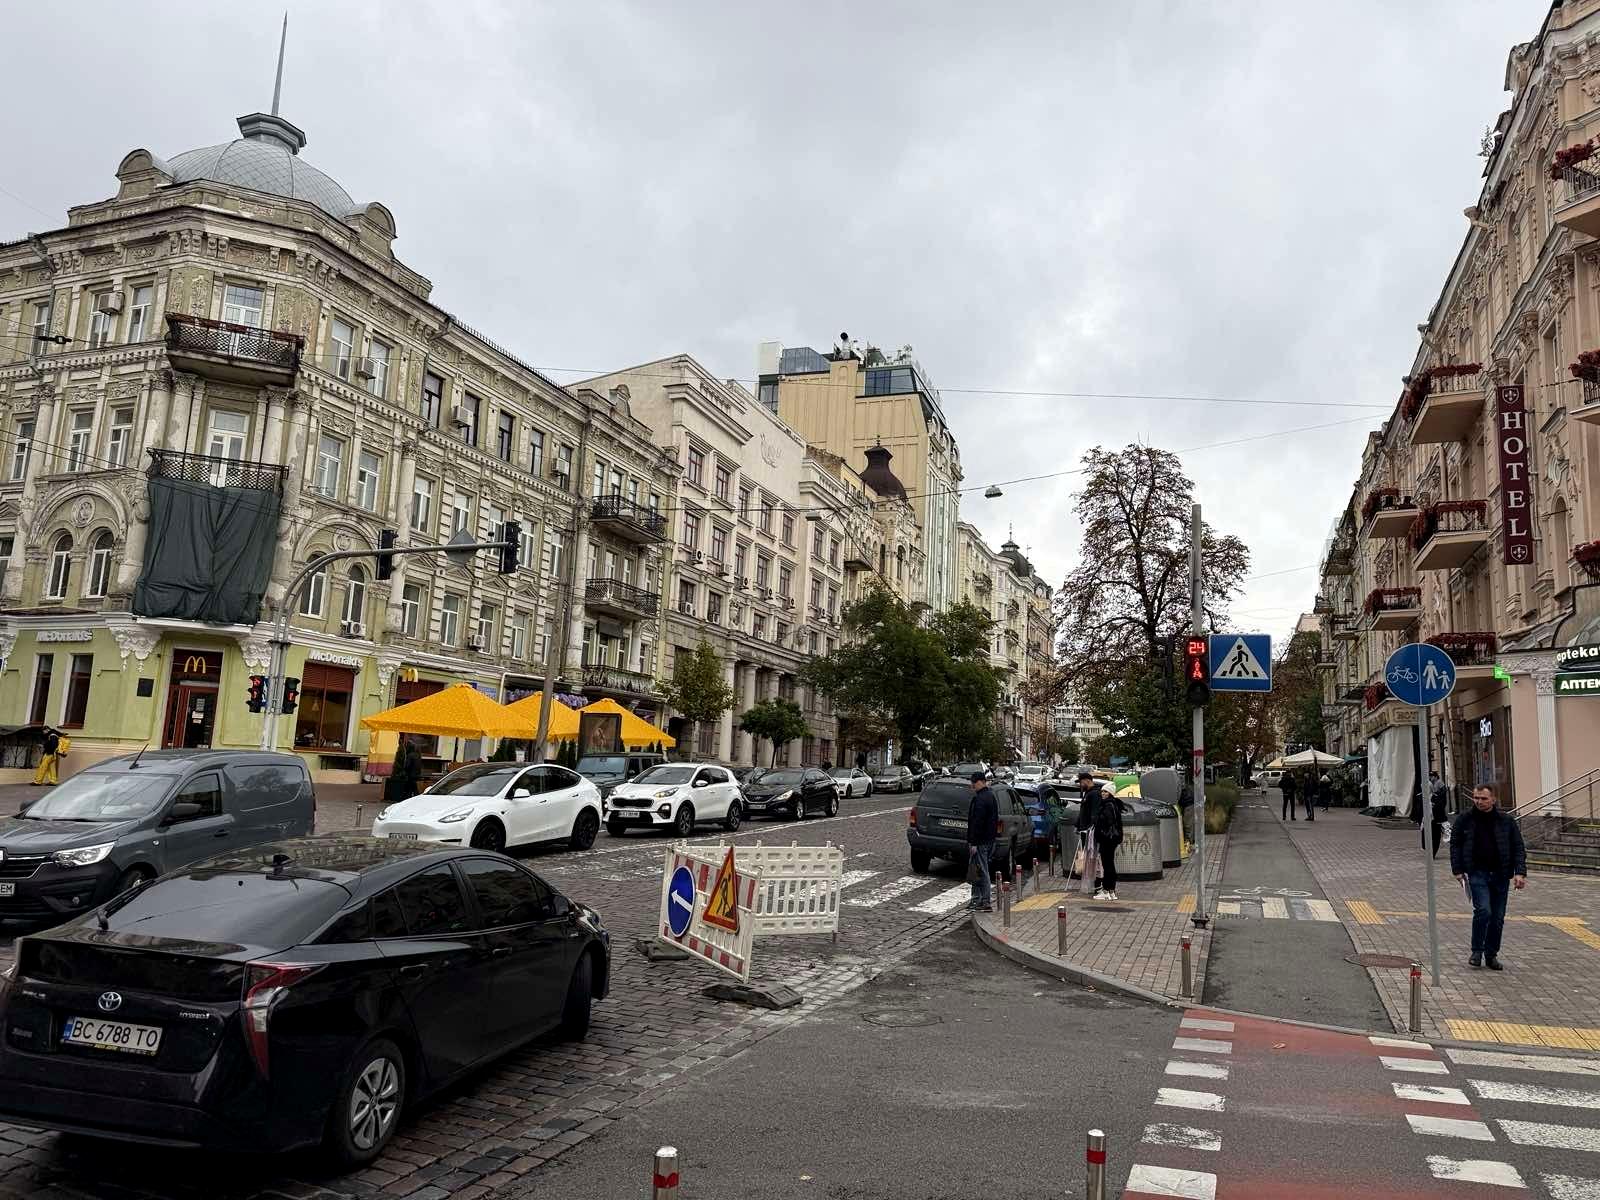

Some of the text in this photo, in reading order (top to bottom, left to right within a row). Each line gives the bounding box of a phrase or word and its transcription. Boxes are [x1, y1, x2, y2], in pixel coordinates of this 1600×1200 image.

[1501, 411, 1527, 537] HOTEL
[1189, 641, 1205, 654] 24
[73, 1020, 158, 1047] BC 6788 TO
